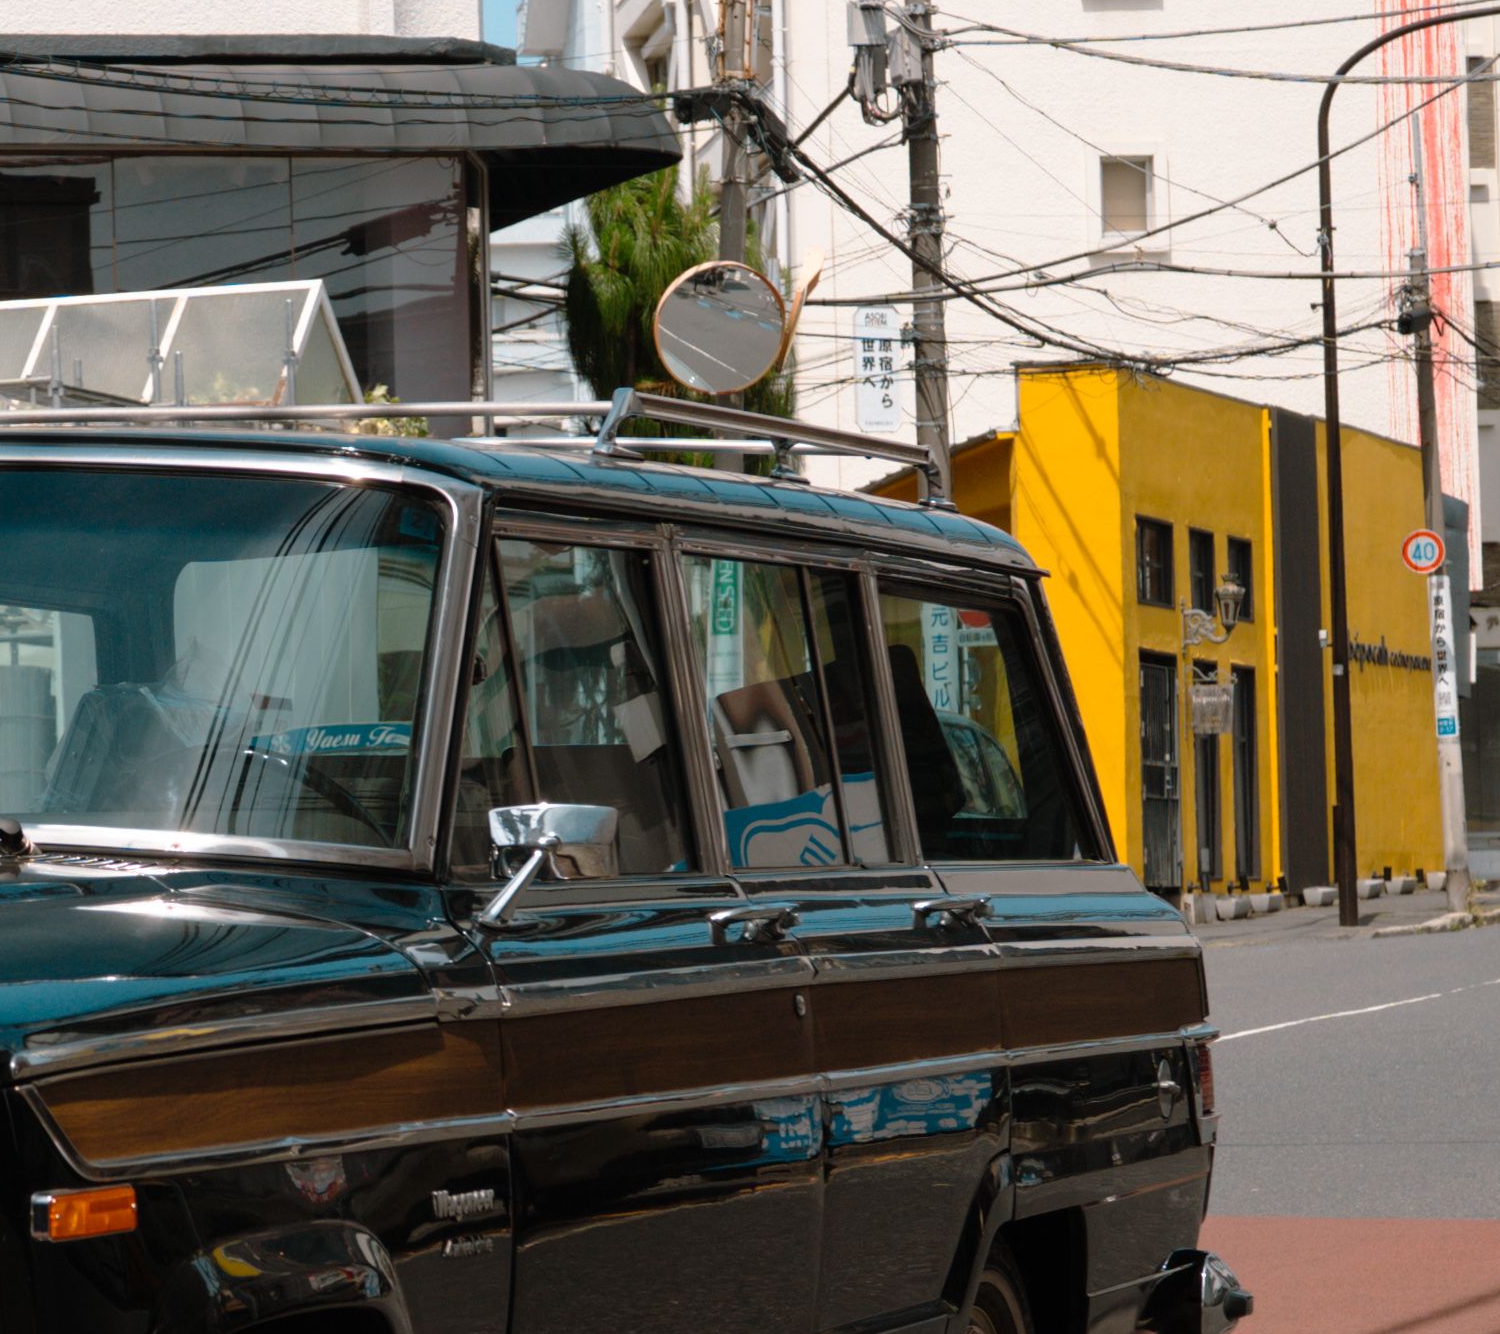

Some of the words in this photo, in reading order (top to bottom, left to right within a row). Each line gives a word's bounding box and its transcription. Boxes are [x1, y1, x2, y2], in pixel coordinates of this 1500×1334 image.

[862, 339, 876, 389] 世界へ
[878, 338, 894, 409] 原宿から
[1412, 541, 1436, 562] 40
[1433, 595, 1449, 685] 原宿から世界へ
[306, 728, 361, 751] Yaesu
